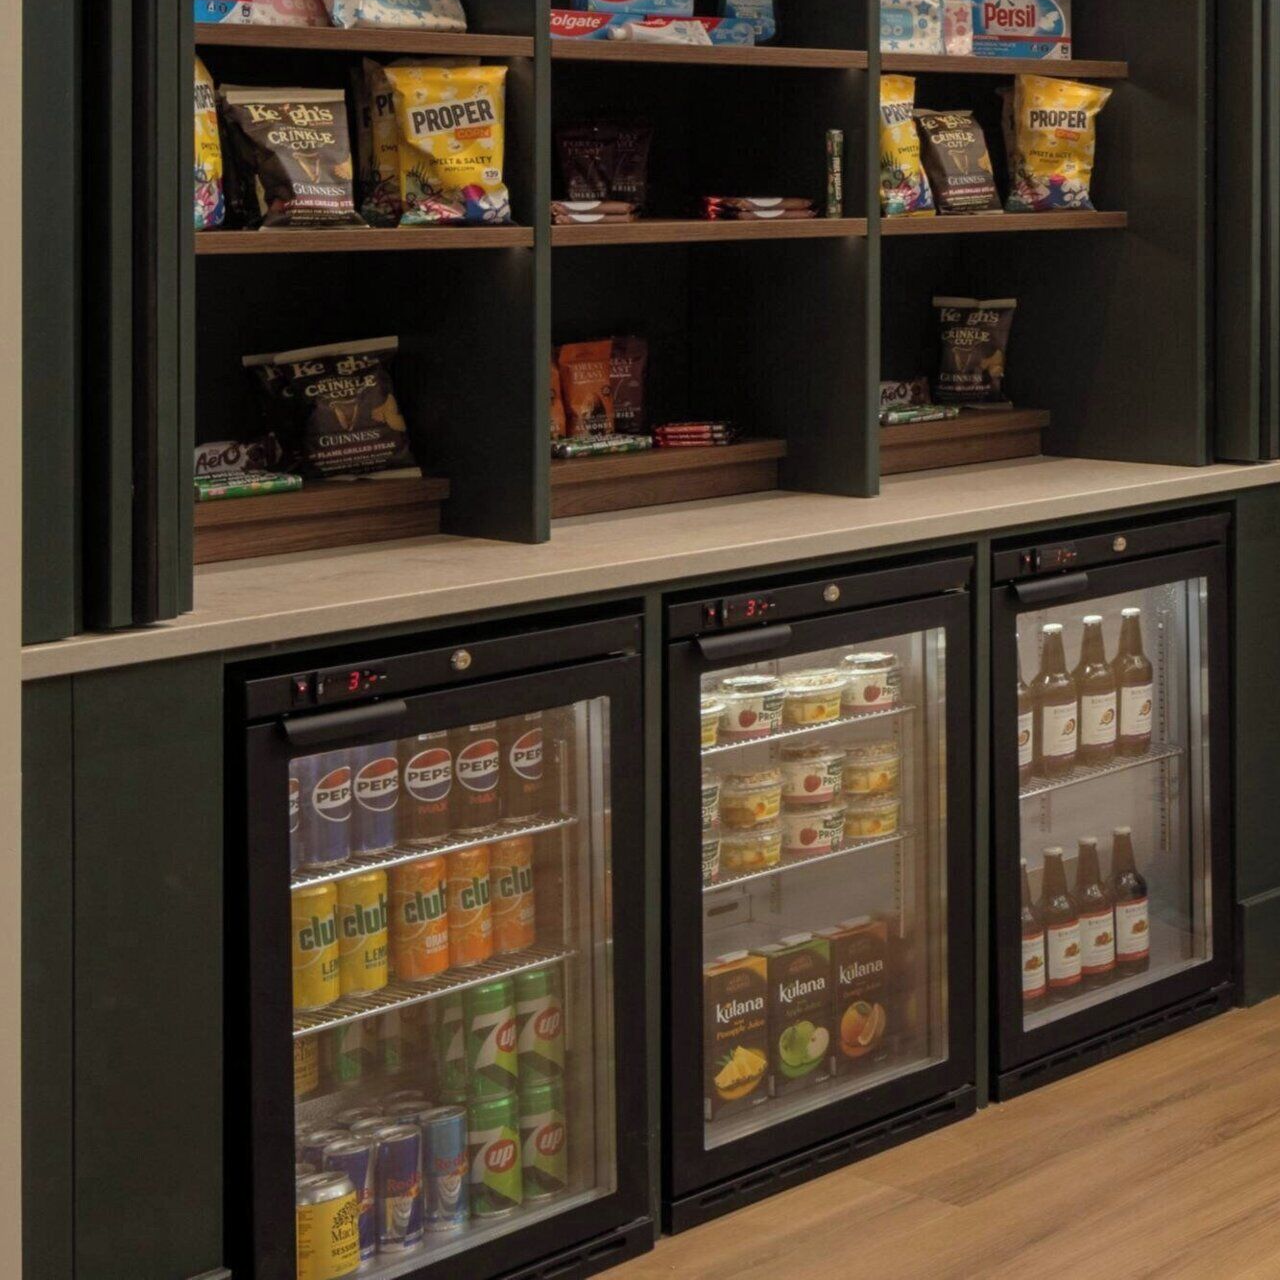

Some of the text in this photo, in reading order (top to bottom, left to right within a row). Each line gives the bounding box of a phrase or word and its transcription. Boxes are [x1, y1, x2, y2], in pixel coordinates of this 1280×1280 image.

[984, 3, 1036, 30] Persil
[411, 99, 494, 134] PROPER
[1029, 110, 1087, 129] PROPER
[267, 130, 335, 145] CRINKLE
[291, 141, 317, 150] CUT
[931, 132, 976, 145] CRINKLE
[292, 182, 347, 196] GUINNESS
[304, 375, 377, 397] CRINKLE
[329, 388, 356, 399] CUT
[319, 430, 381, 447] GUINNESS
[317, 441, 396, 458] FLAME GRILLED STEAK
[746, 599, 757, 617] 3
[348, 671, 360, 690] 3
